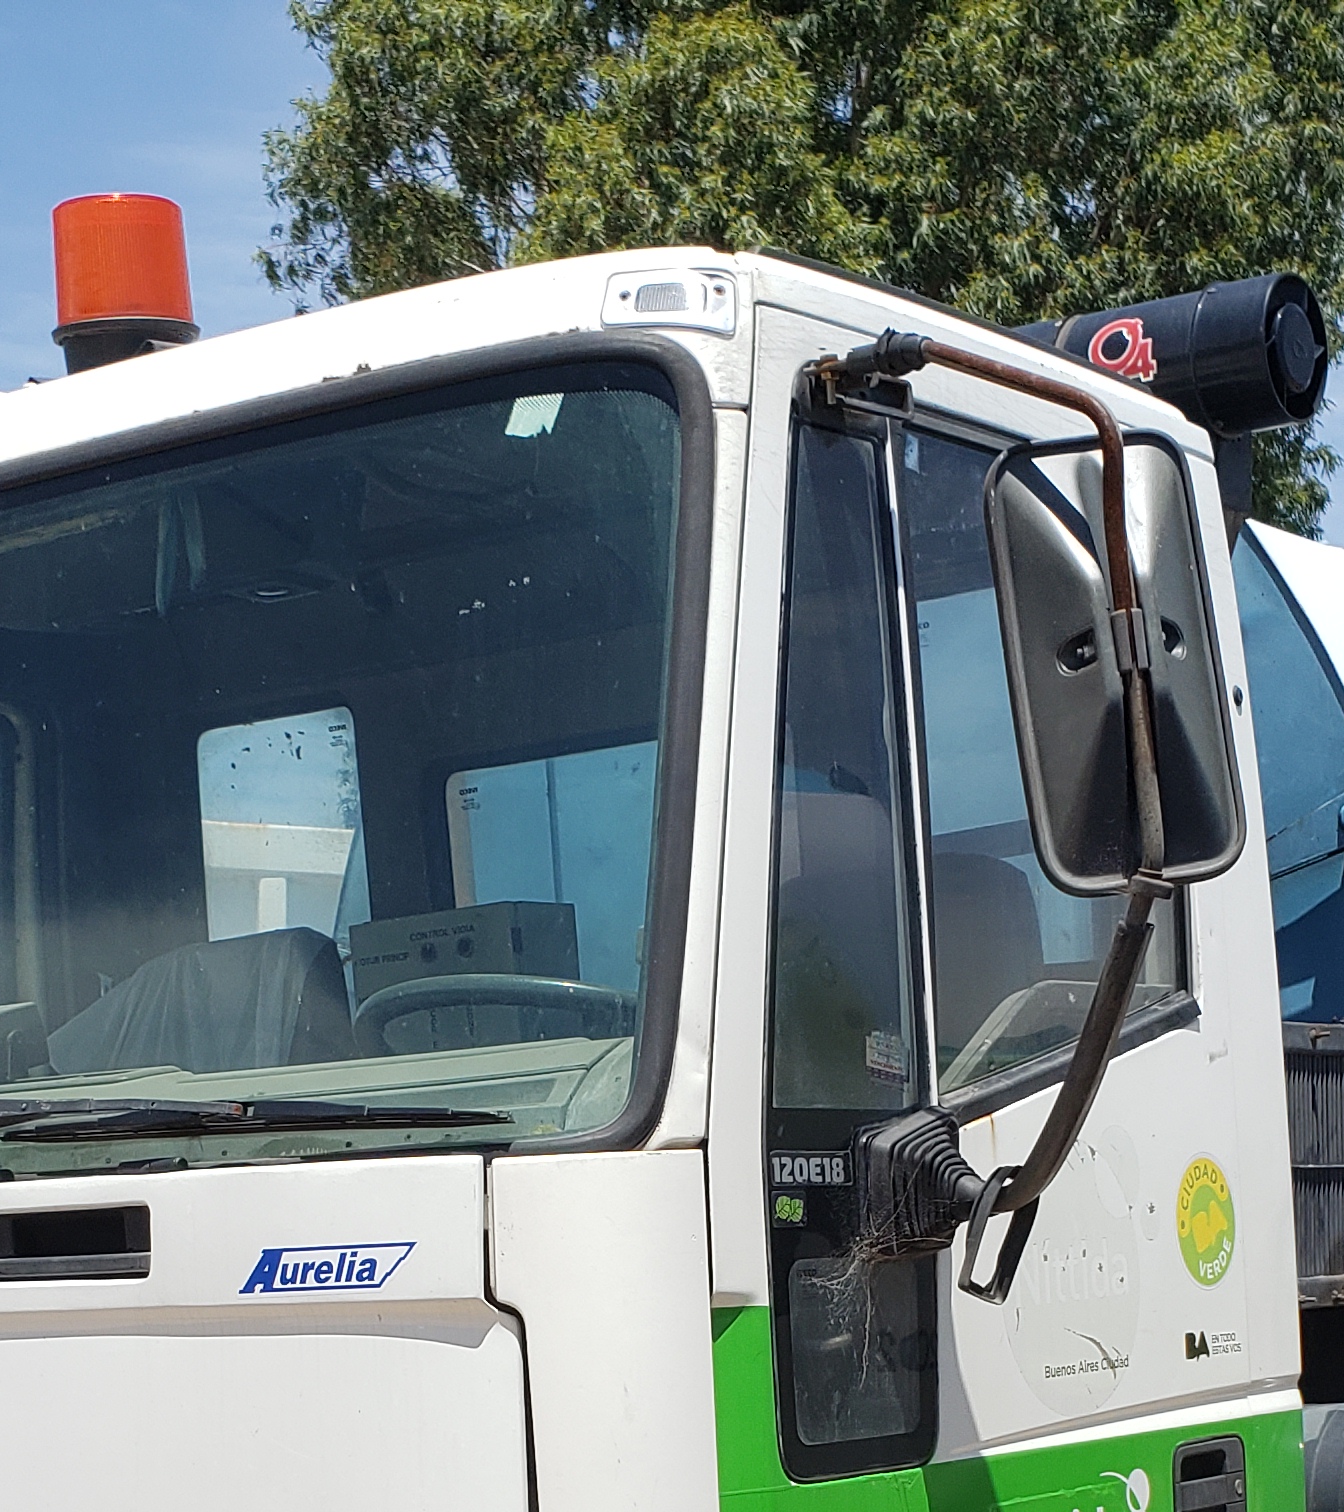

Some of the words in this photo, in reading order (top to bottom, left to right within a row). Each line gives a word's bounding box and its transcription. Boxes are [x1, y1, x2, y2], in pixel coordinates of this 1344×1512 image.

[1181, 1164, 1218, 1211] CIUDAD
[238, 1249, 378, 1295] Aurelia
[1199, 1236, 1232, 1279] VERDE
[1044, 1364, 1076, 1379] Buenos
[1077, 1360, 1099, 1374] Aires
